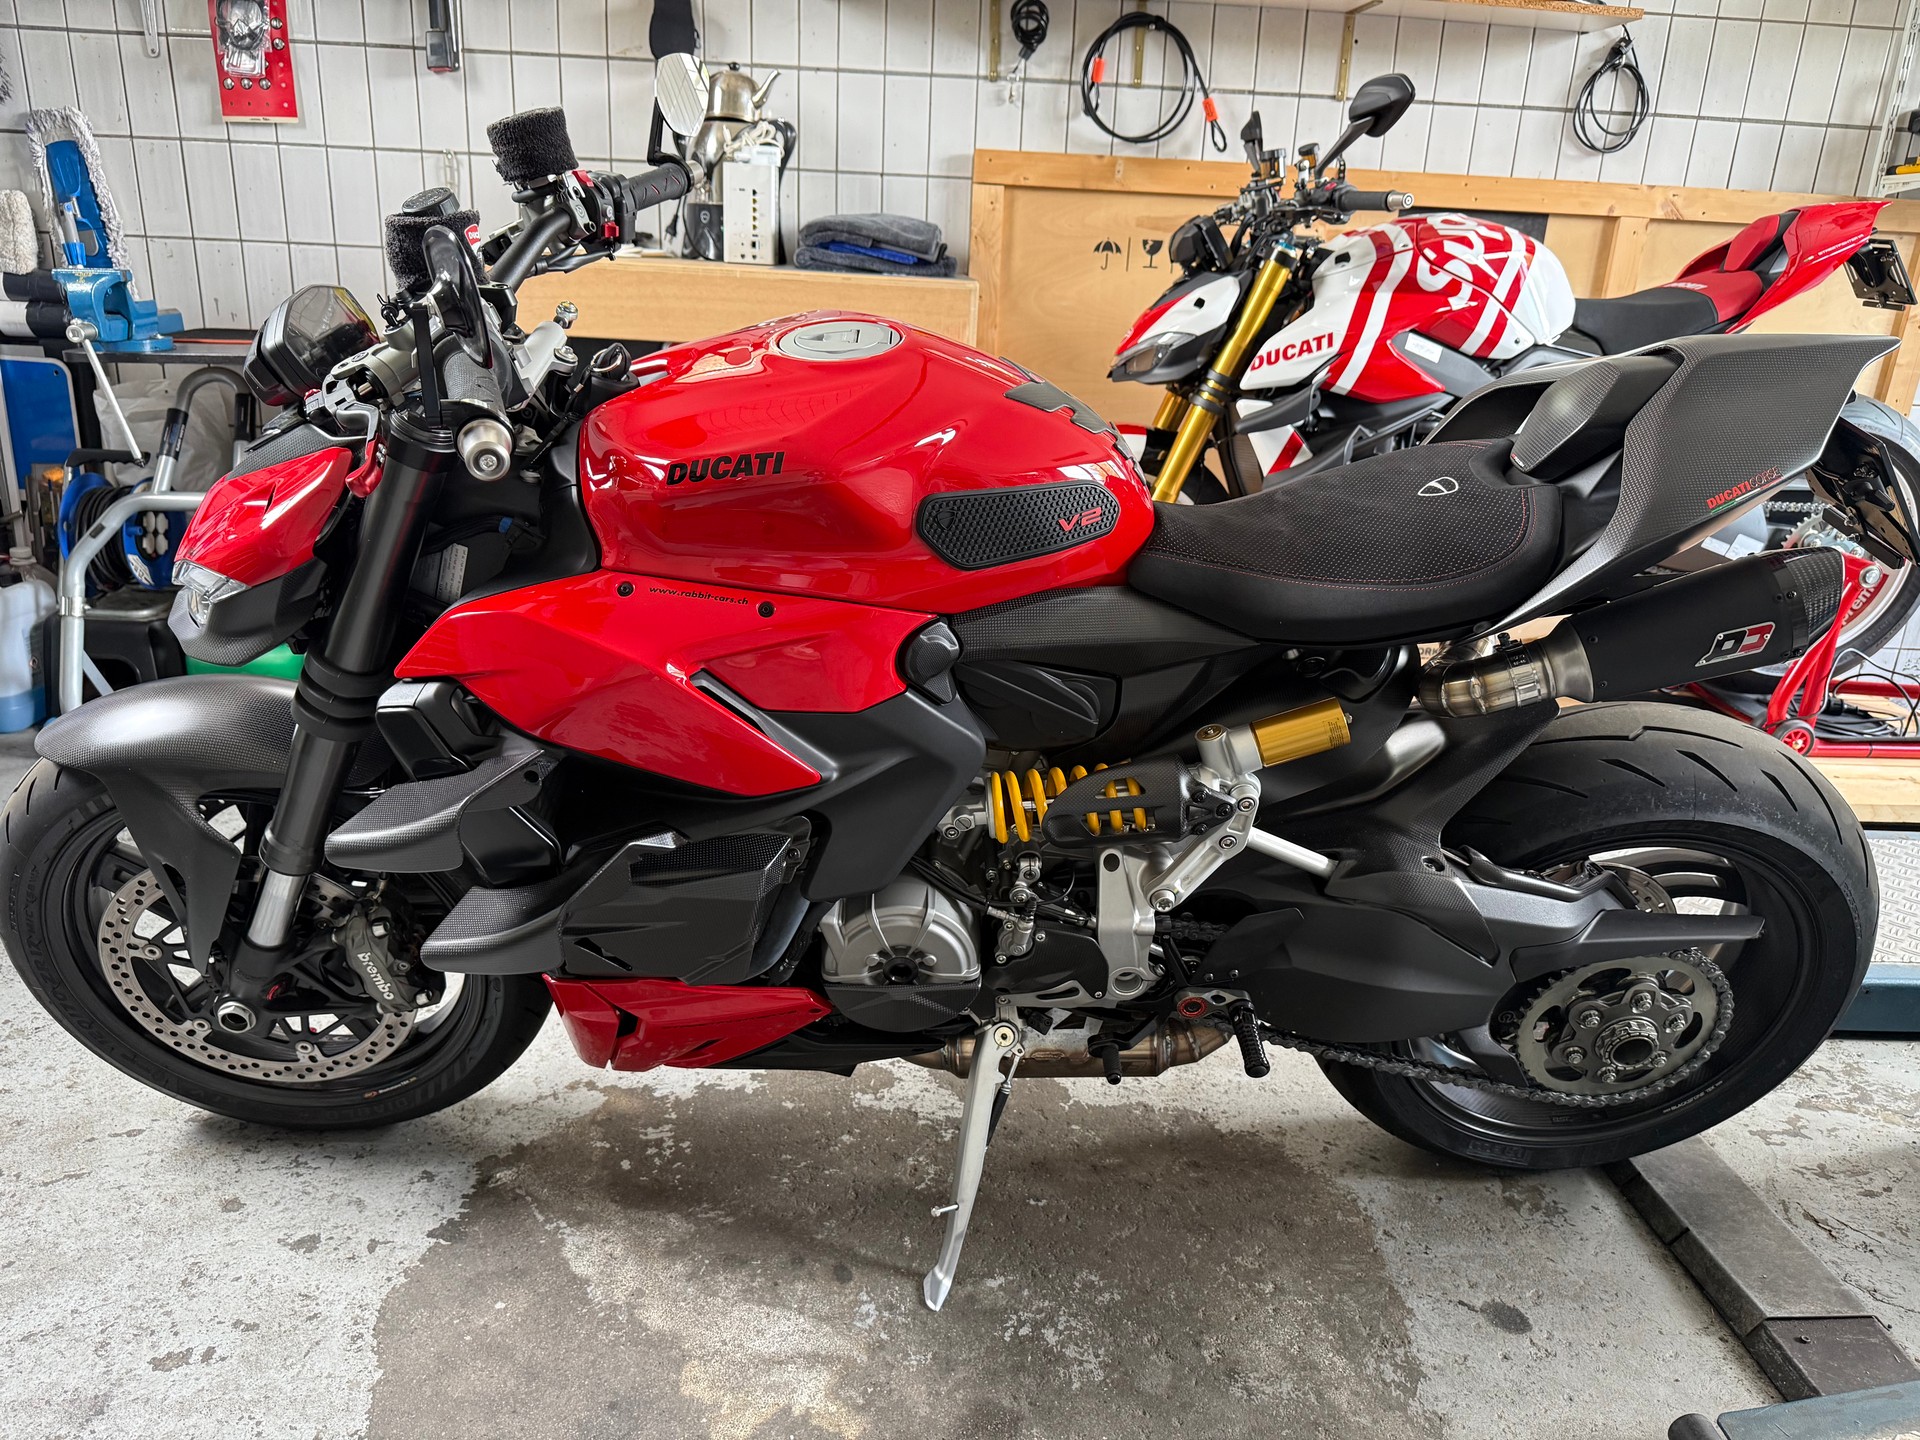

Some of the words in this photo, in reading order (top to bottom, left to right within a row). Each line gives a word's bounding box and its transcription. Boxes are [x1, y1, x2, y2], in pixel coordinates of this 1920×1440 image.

[1250, 332, 1334, 372] DUCATI
[666, 452, 785, 485] DUCATI
[1706, 480, 1752, 509] DUCATI
[1058, 506, 1103, 532] V2
[649, 586, 749, 605] www.rabbit-cars.ch
[357, 952, 395, 1000] brembo
